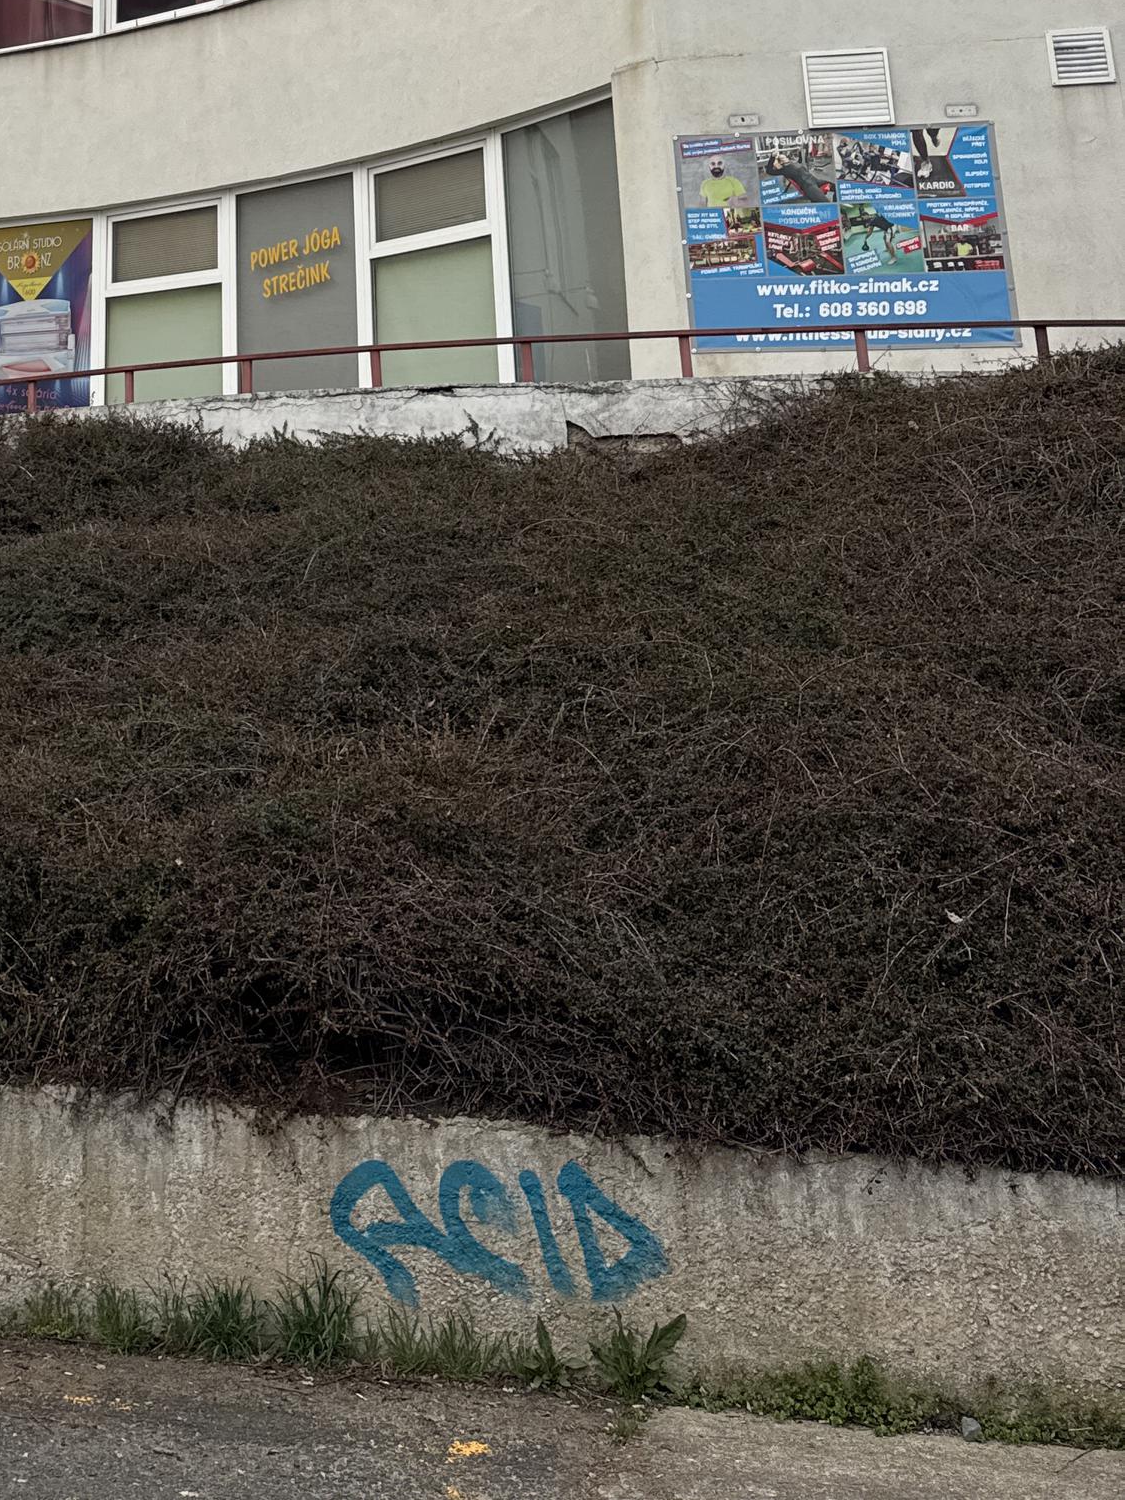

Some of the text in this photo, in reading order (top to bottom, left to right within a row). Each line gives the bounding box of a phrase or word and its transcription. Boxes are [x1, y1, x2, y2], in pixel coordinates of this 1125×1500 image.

[765, 134, 825, 147] POSILOVNA
[919, 181, 955, 190] KARDIO
[778, 216, 821, 225] POSILOVNA
[951, 224, 969, 232] BAR
[32, 236, 62, 249] STUDIO
[250, 226, 341, 272] POWER JÓGA
[262, 260, 331, 298] STREČINK
[756, 277, 939, 296] www.fitko-zimak.cz
[773, 300, 927, 319] Tel.: 608 360 698
[330, 1159, 671, 1310] ACID
